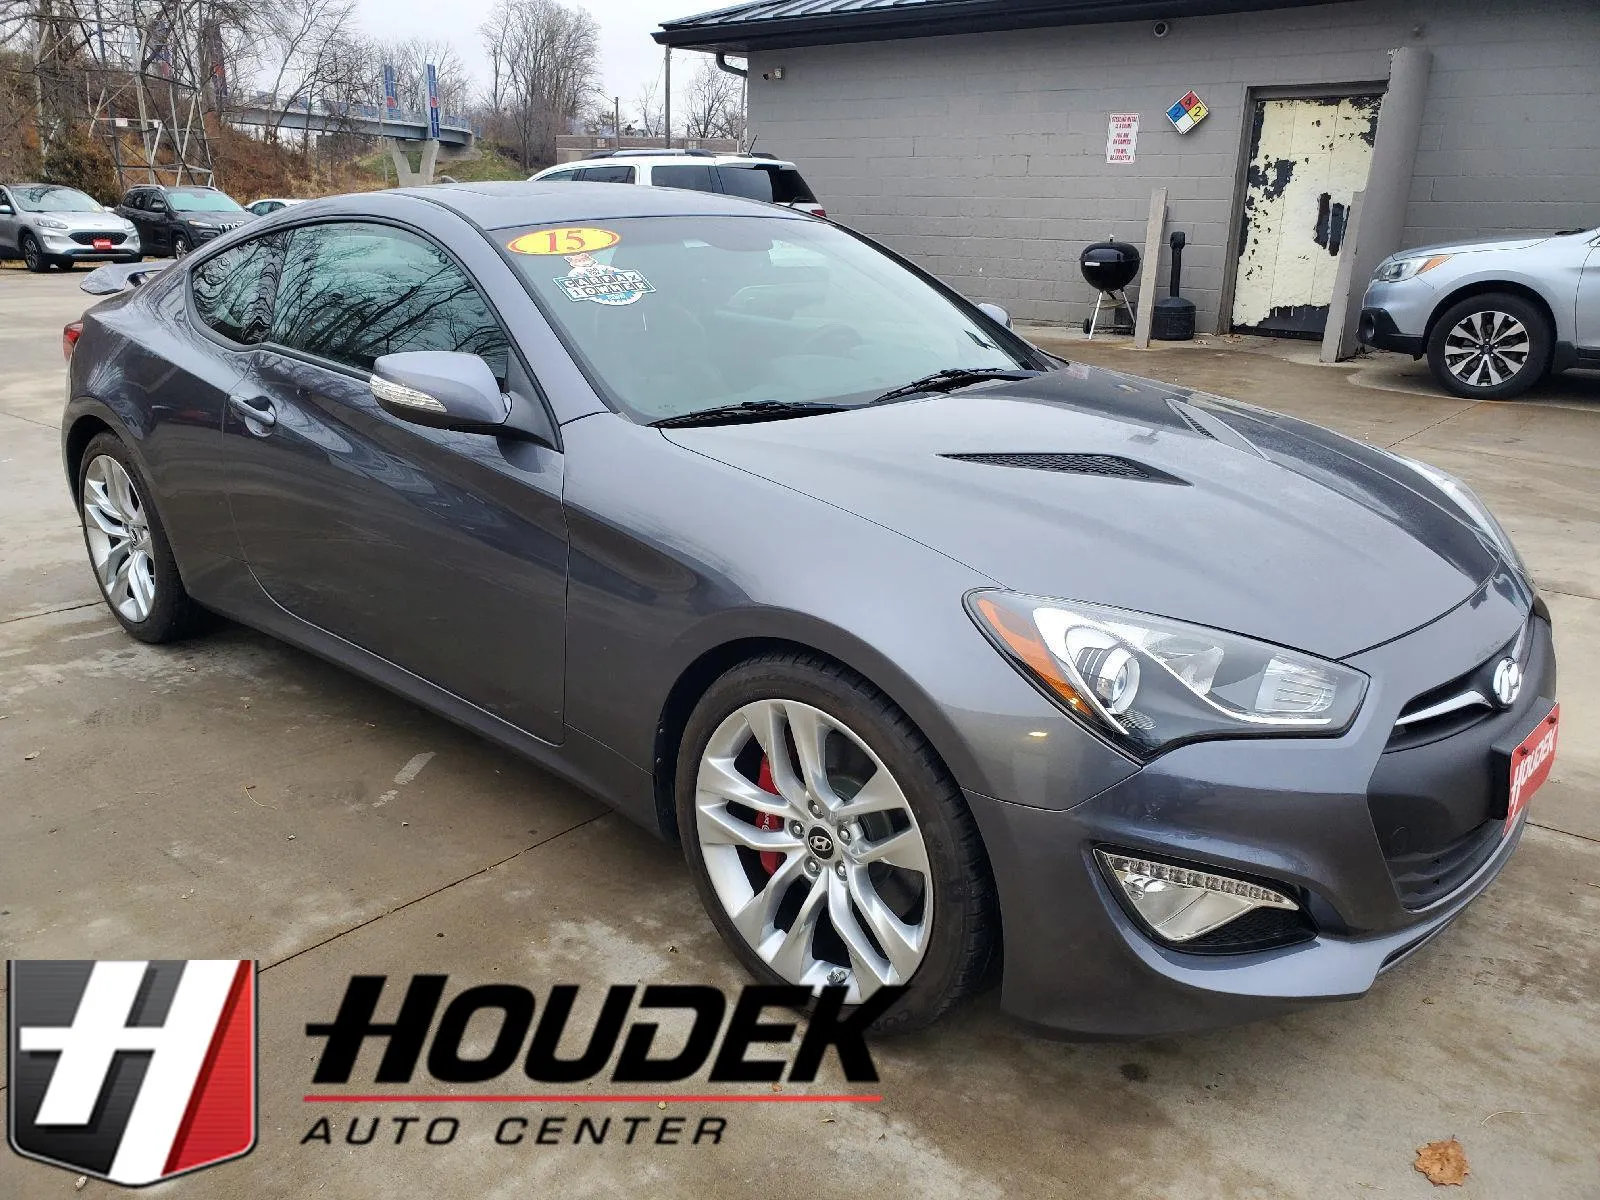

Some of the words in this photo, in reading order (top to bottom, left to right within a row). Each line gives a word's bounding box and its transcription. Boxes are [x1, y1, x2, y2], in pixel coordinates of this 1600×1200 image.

[1185, 96, 1192, 107] 4
[1173, 106, 1182, 118] 2
[1194, 105, 1202, 117] 2
[545, 229, 586, 253] 15
[563, 273, 641, 288] CARFAX
[584, 281, 648, 296] OWNER
[1510, 726, 1557, 820] HOUDEK
